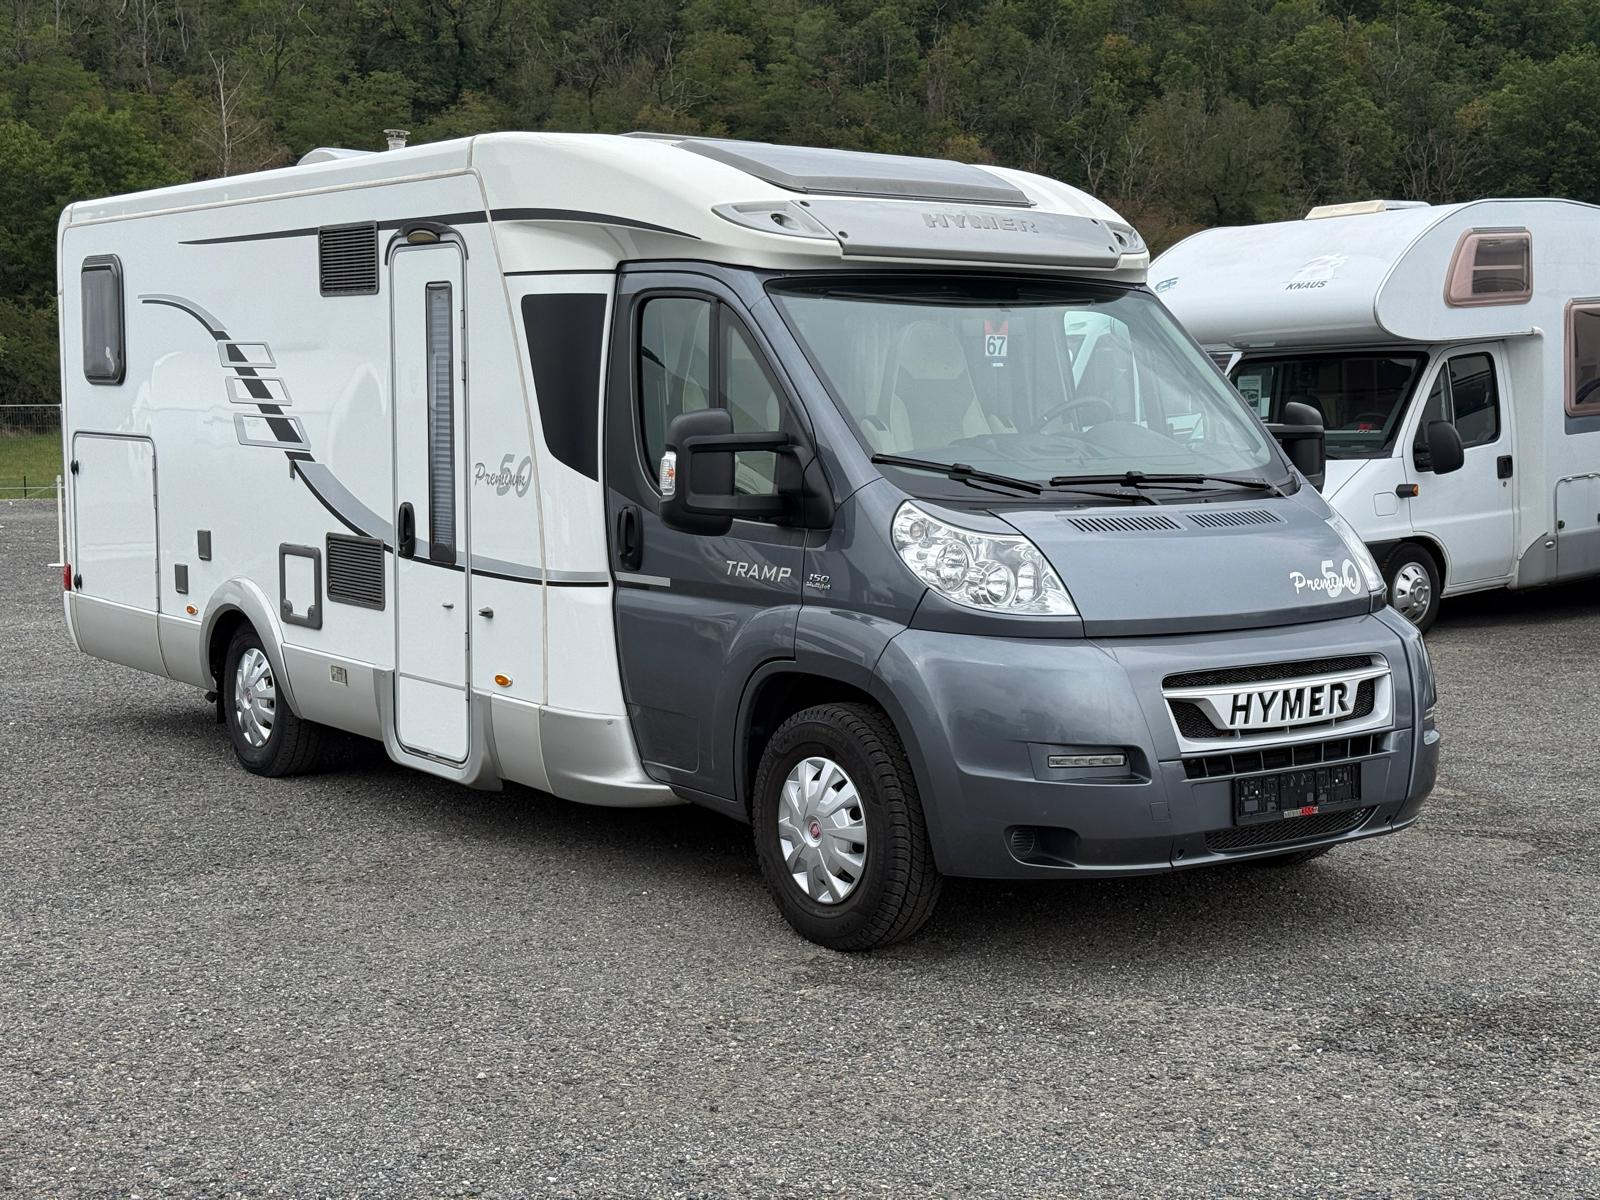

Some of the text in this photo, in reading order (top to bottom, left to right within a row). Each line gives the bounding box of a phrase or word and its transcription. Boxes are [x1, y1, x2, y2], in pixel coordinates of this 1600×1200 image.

[922, 212, 1039, 233] HYMER
[1286, 280, 1328, 291] KNAUS
[987, 335, 1006, 355] 67
[496, 453, 532, 498] 50
[726, 560, 792, 582] TRAMP
[809, 573, 830, 583] 150
[1321, 558, 1361, 598] 50
[1229, 682, 1350, 726] HYMER
